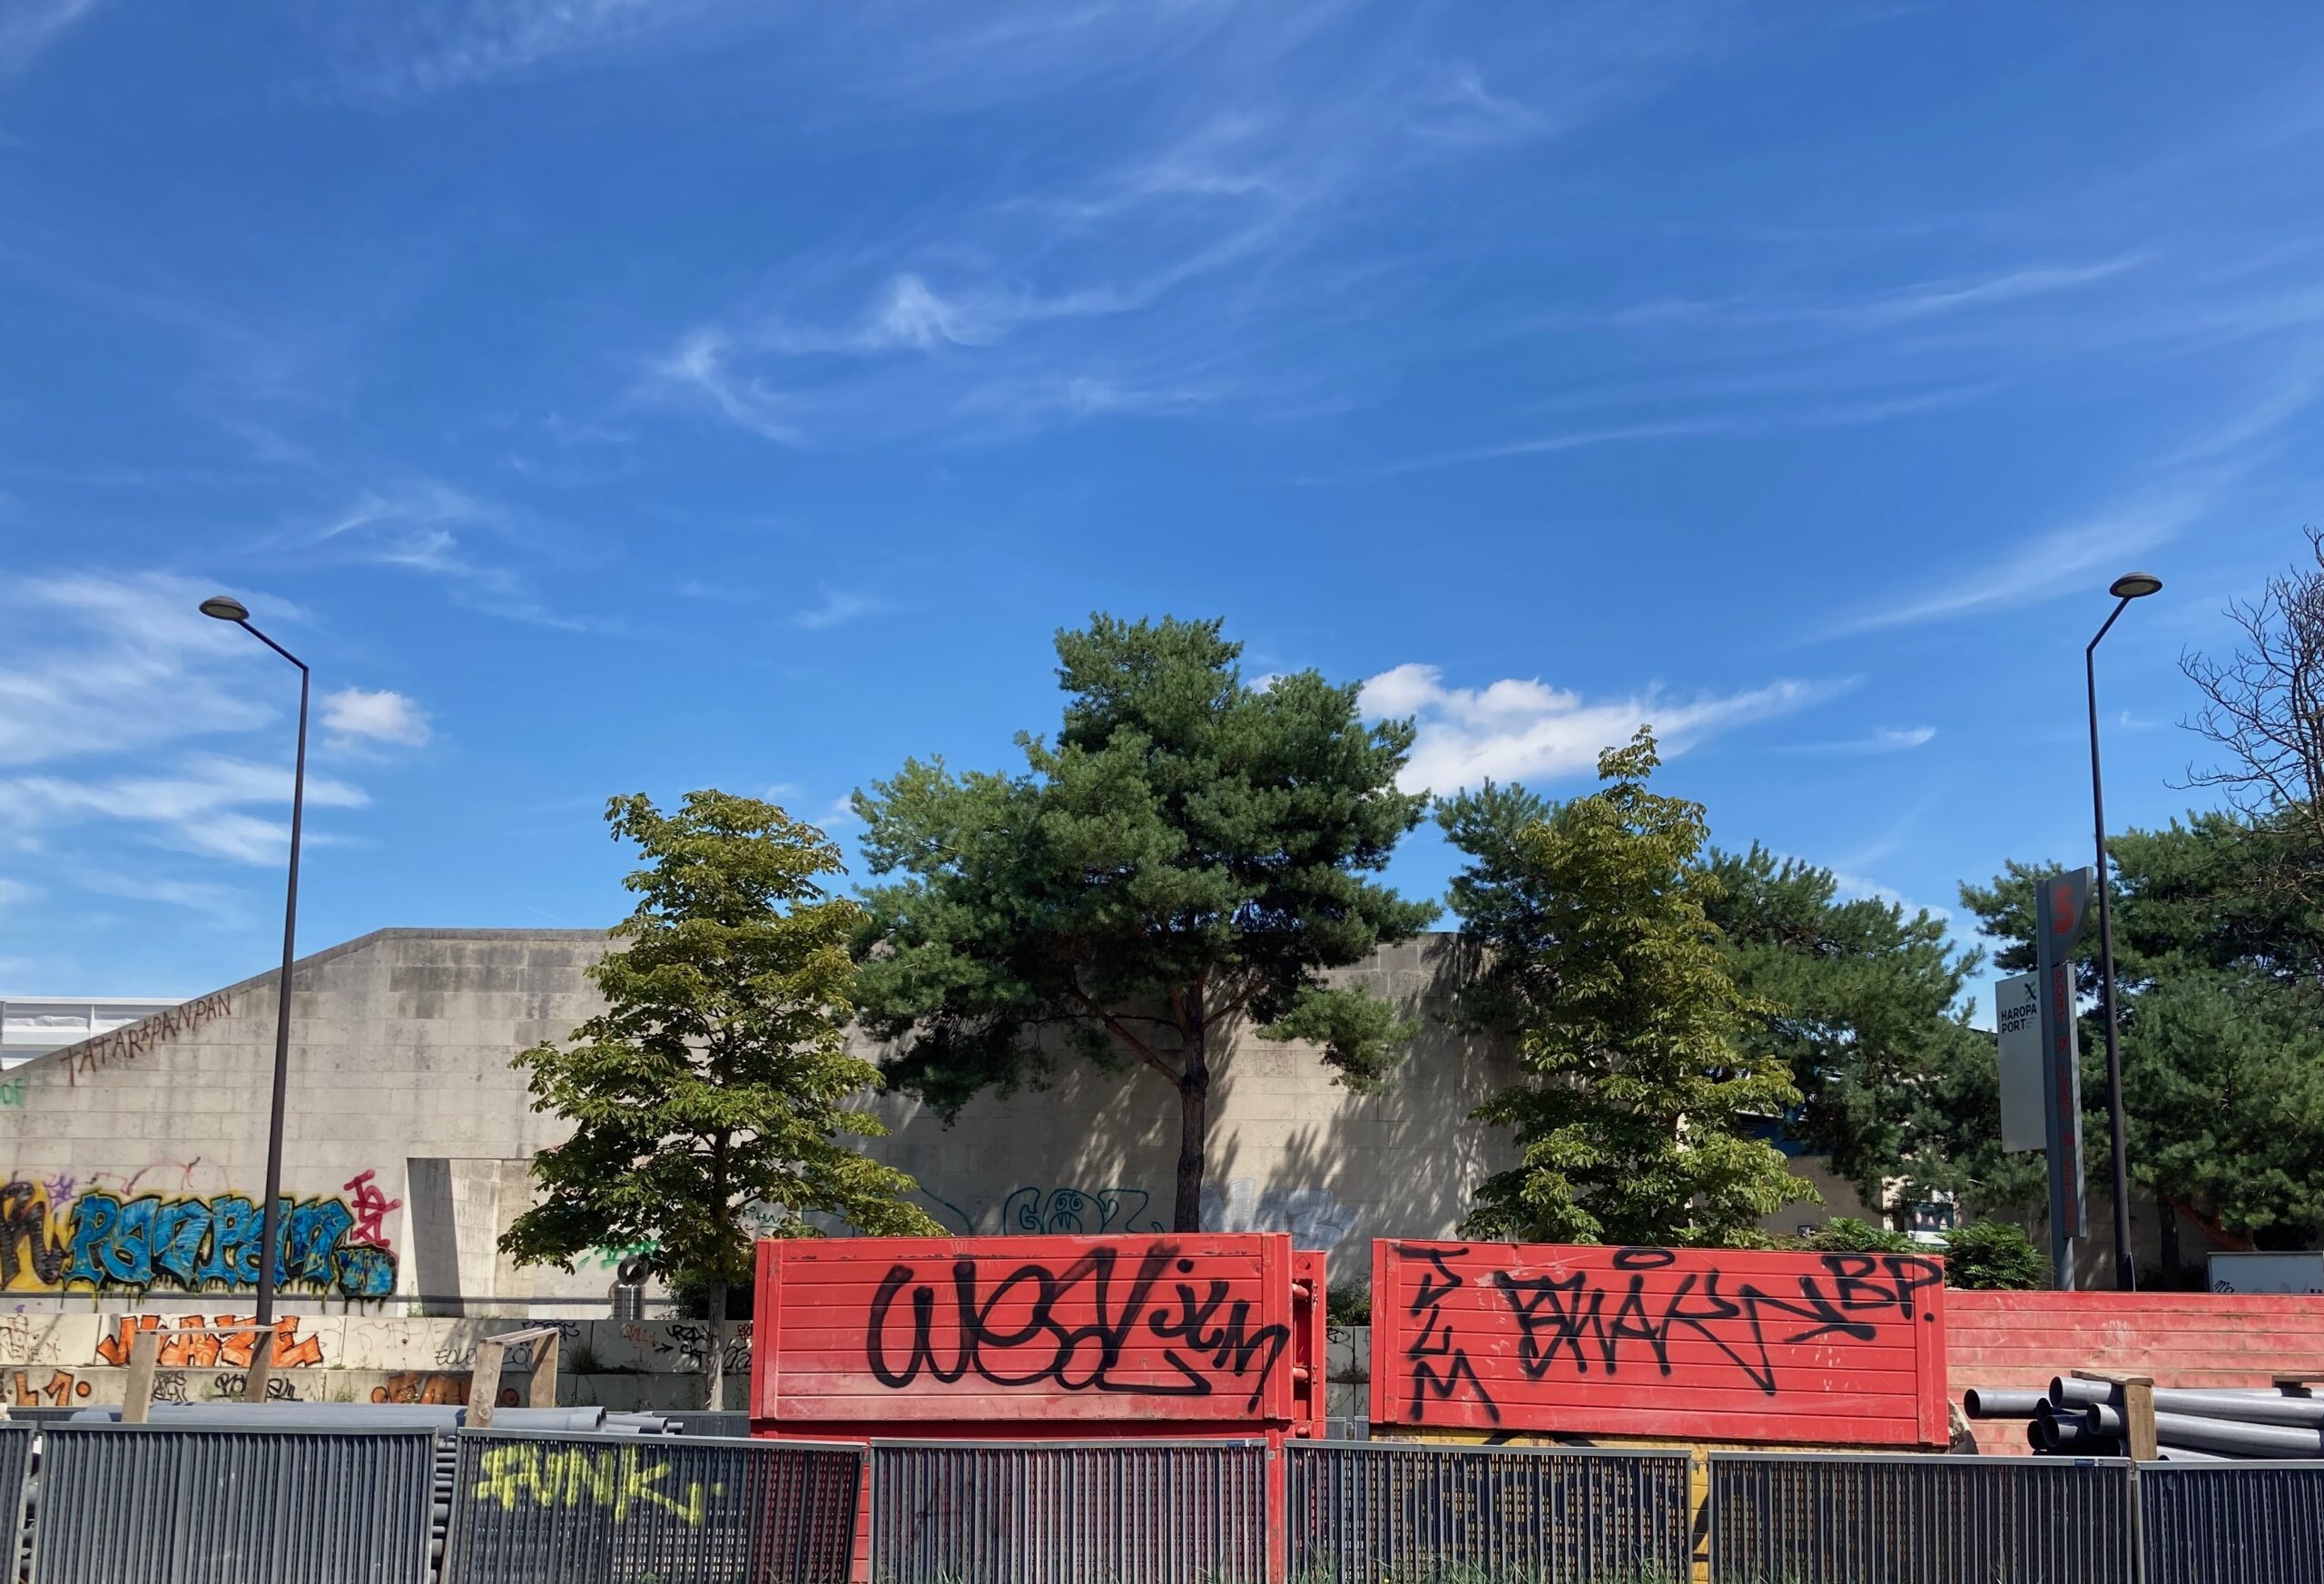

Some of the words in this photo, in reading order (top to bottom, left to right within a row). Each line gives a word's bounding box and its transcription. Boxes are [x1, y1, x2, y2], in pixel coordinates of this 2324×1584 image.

[2053, 884, 2074, 934] 5
[2001, 1003, 2038, 1022] HAROPA
[2002, 1018, 2026, 1034] PORT
